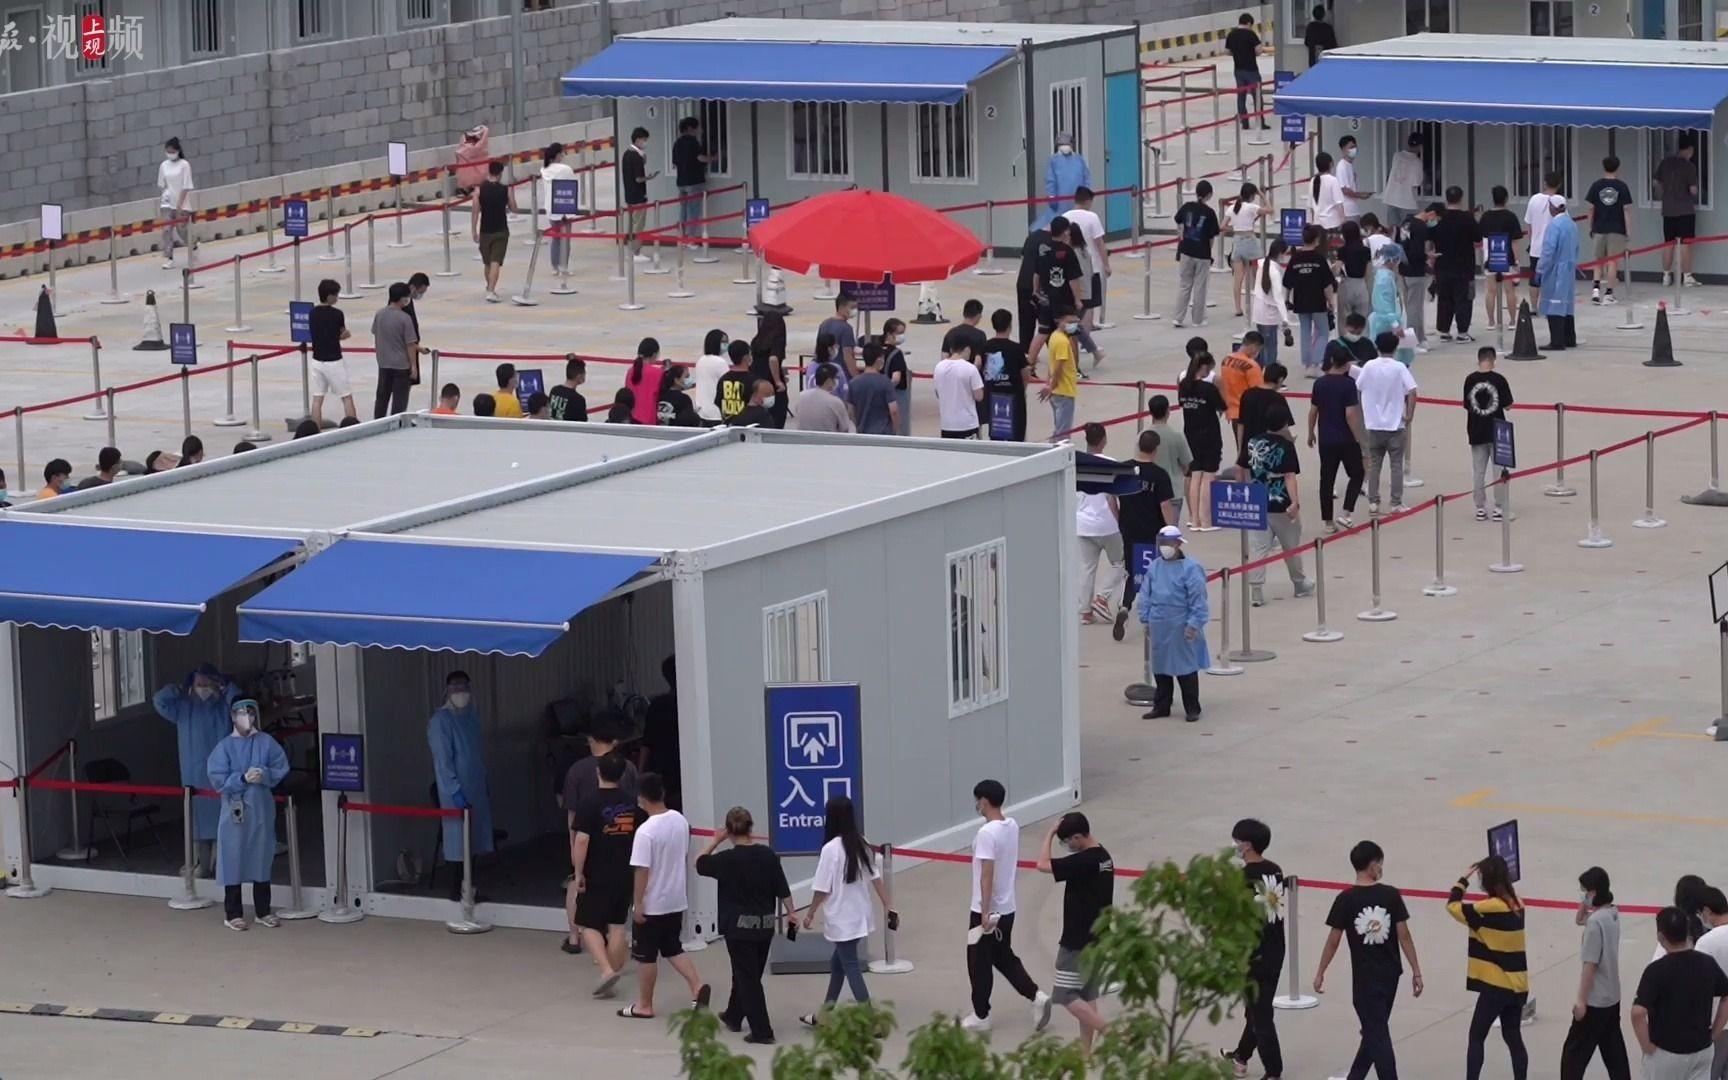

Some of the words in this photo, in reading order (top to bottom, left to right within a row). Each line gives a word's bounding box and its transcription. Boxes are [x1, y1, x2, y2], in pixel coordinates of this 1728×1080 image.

[1591, 5, 1598, 14] 2
[649, 106, 655, 117] 1
[987, 106, 994, 118] 2
[1352, 118, 1359, 130] 3
[1142, 550, 1153, 569] 5
[780, 775, 852, 808] 入口
[779, 813, 827, 828] Entra
